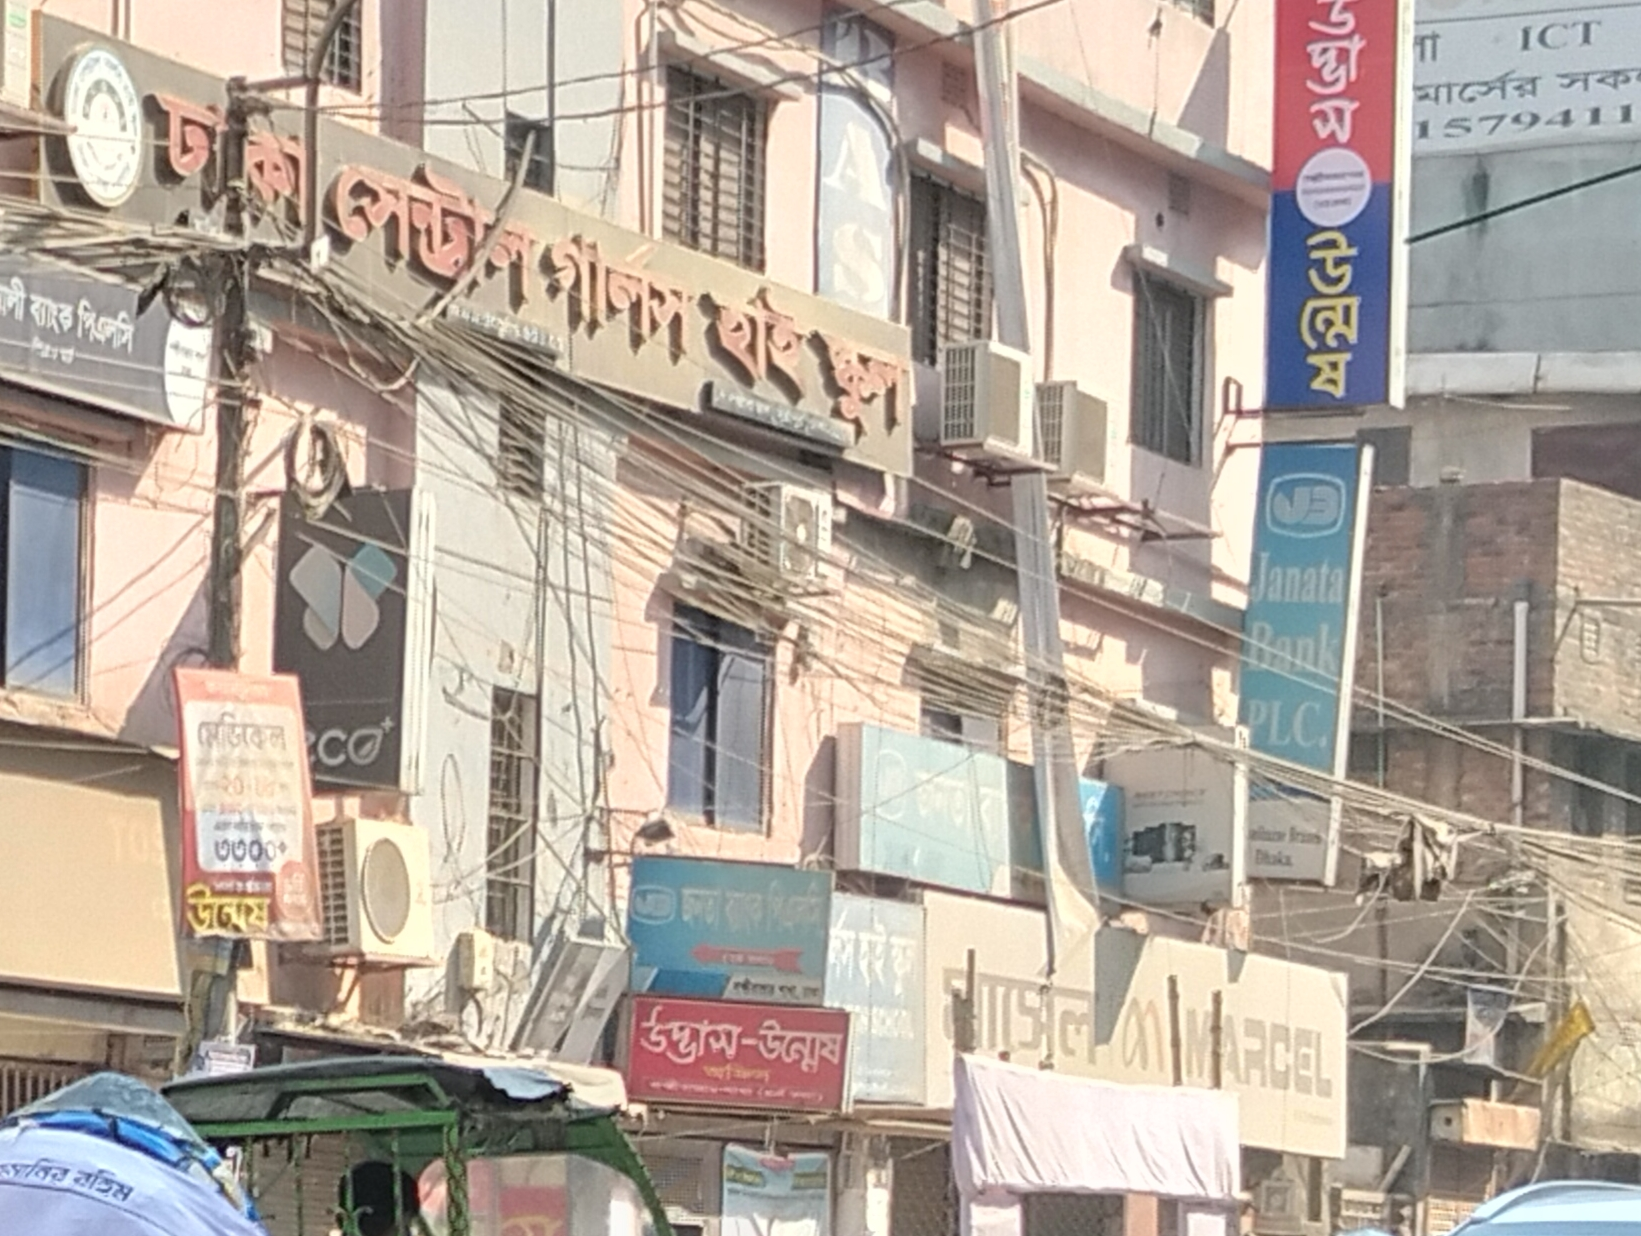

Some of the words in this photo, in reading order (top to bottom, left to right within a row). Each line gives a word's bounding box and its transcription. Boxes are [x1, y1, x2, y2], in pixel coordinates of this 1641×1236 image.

[1519, 19, 1602, 52] ICT
[1556, 67, 1641, 92] সক
[29, 293, 75, 334] ব্যাংক
[77, 297, 135, 354] পিএলসি
[1301, 230, 1361, 398] উন্মেষ
[715, 279, 805, 390] হাই
[824, 335, 911, 428] স্কুল
[1252, 552, 1344, 603] Janata
[1248, 620, 1338, 671] Bank
[1248, 700, 1328, 748] PLC.
[640, 1005, 843, 1073] উদ্ভাস-উন্মেষ
[1186, 1007, 1333, 1098] MARCEL
